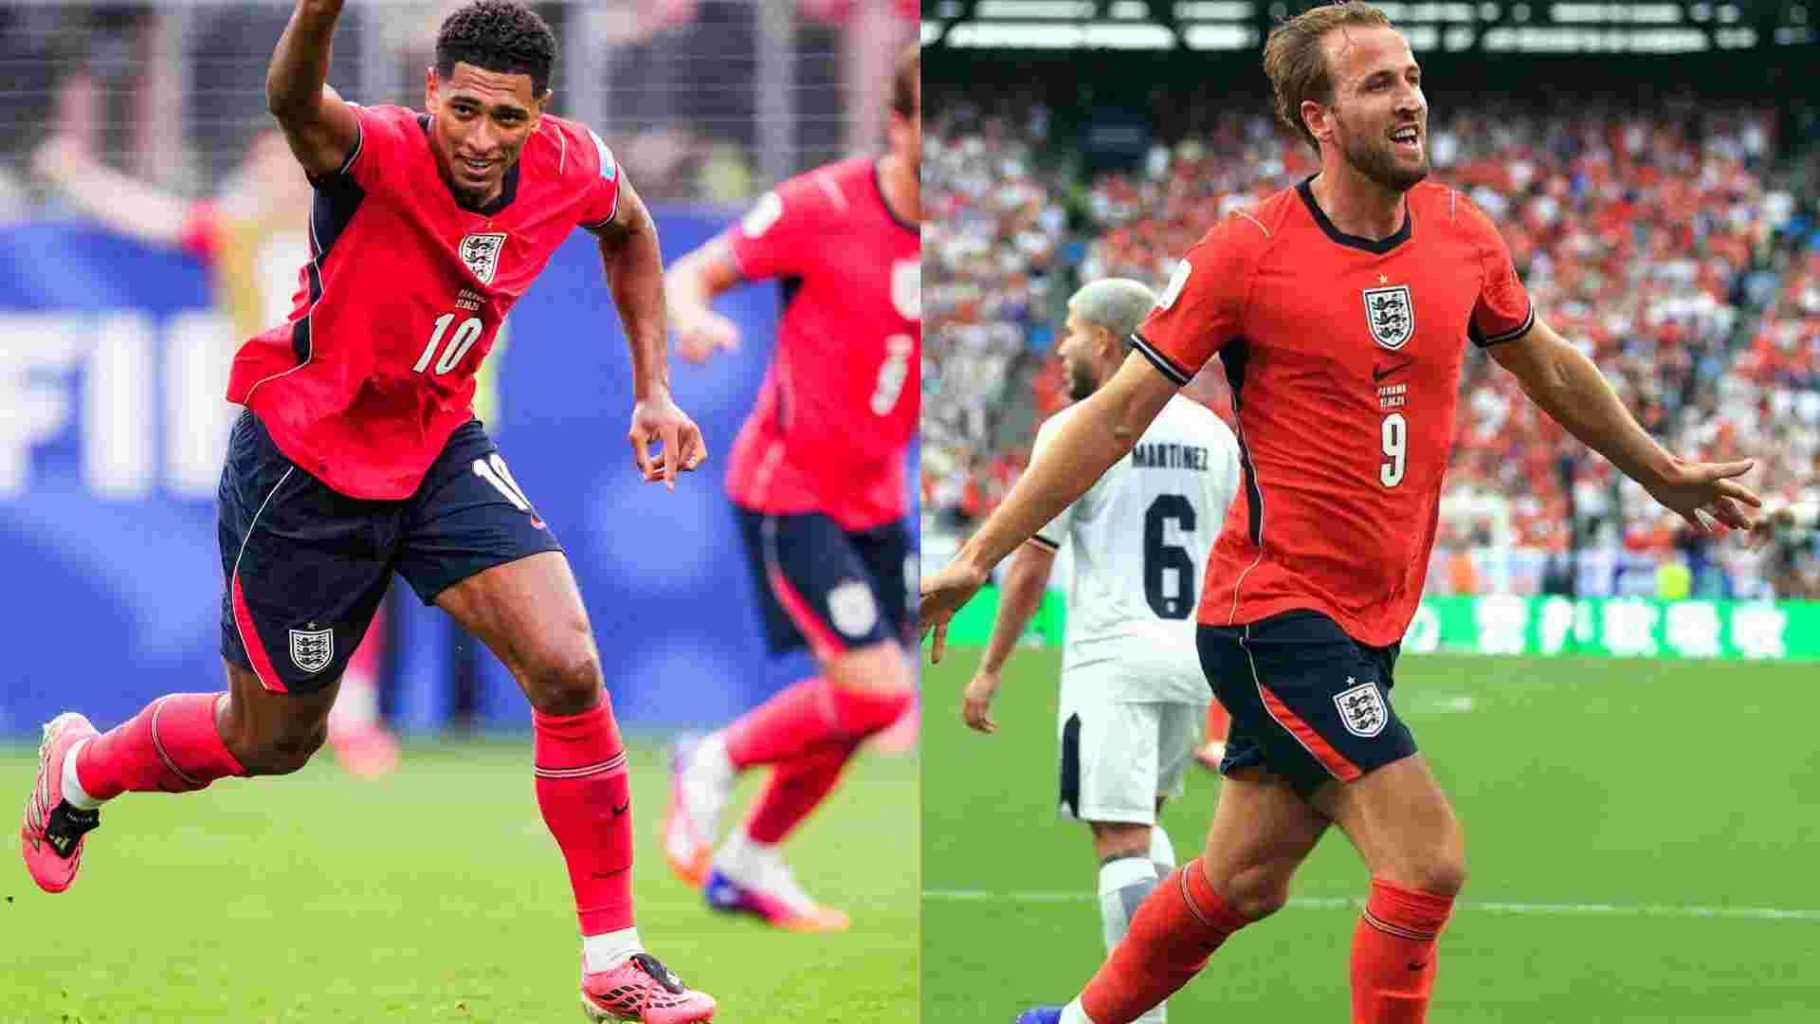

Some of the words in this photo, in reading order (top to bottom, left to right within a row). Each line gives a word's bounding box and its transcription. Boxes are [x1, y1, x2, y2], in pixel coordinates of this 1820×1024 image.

[412, 312, 483, 375] 10
[472, 453, 531, 511] 10
[1381, 412, 1406, 488] 9
[1143, 494, 1196, 620] 6
